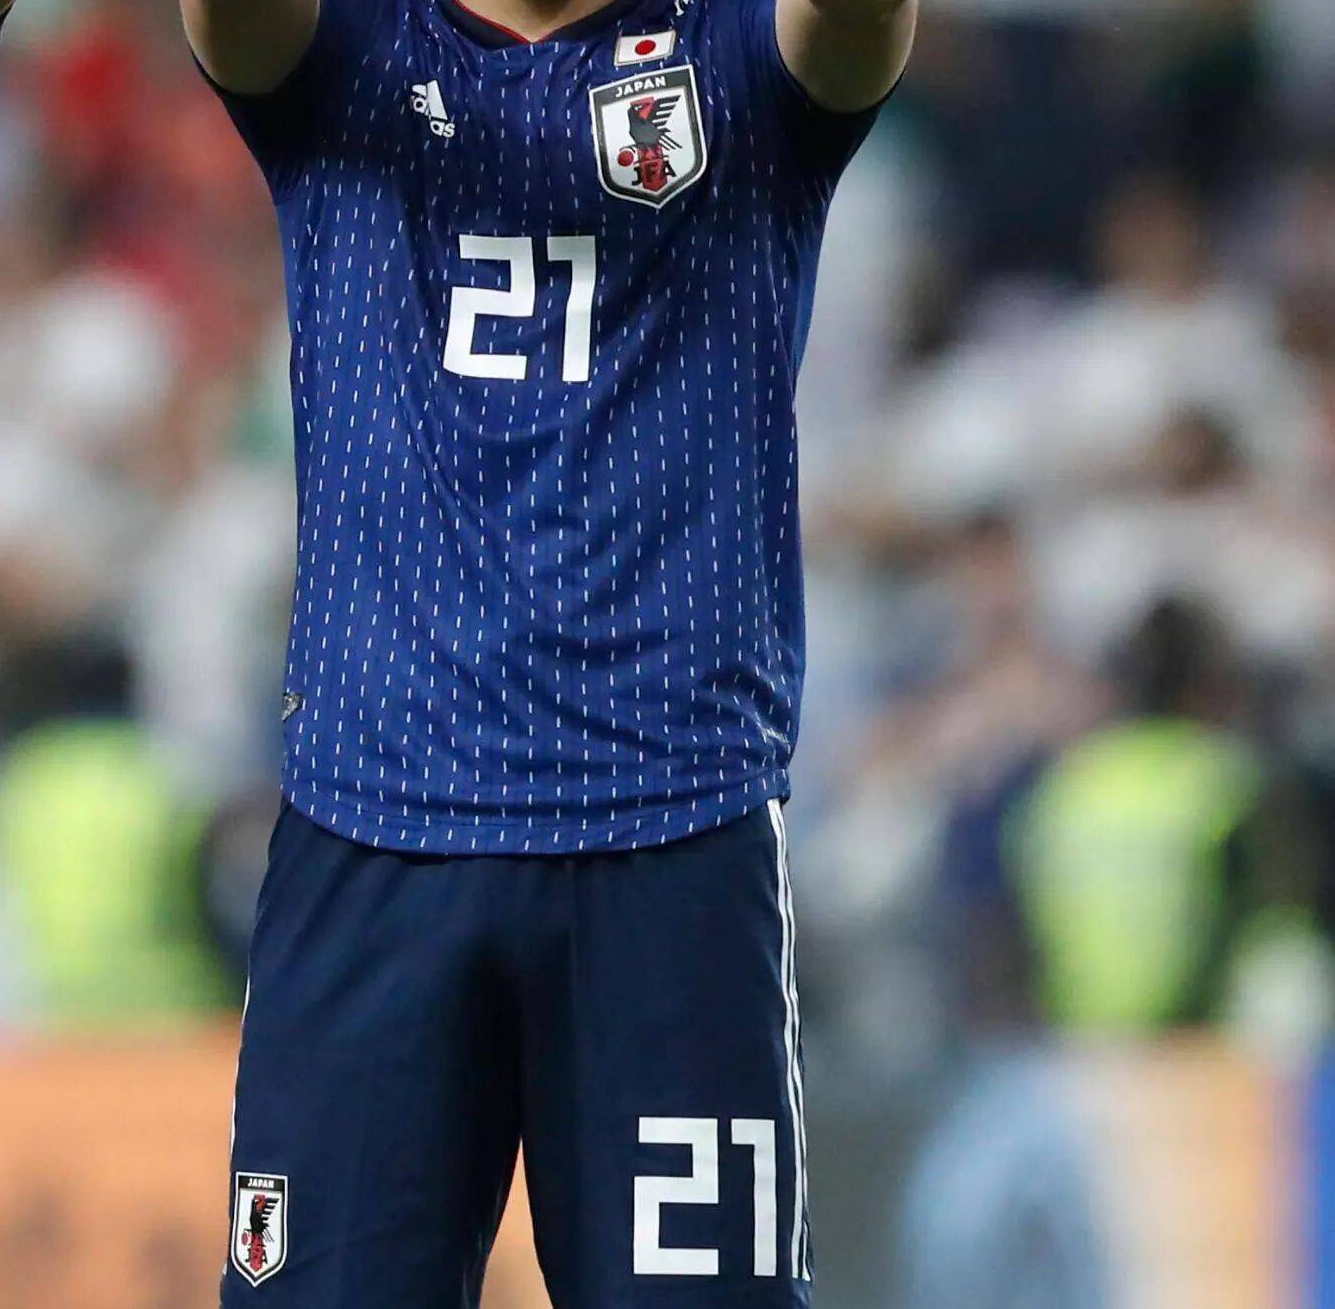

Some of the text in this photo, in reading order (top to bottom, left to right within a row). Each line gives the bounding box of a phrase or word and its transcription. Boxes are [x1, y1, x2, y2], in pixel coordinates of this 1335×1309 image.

[615, 76, 667, 98] JAPAN
[443, 235, 596, 381] 21
[247, 1178, 274, 1189] JAPAN
[633, 1117, 776, 1276] 21
